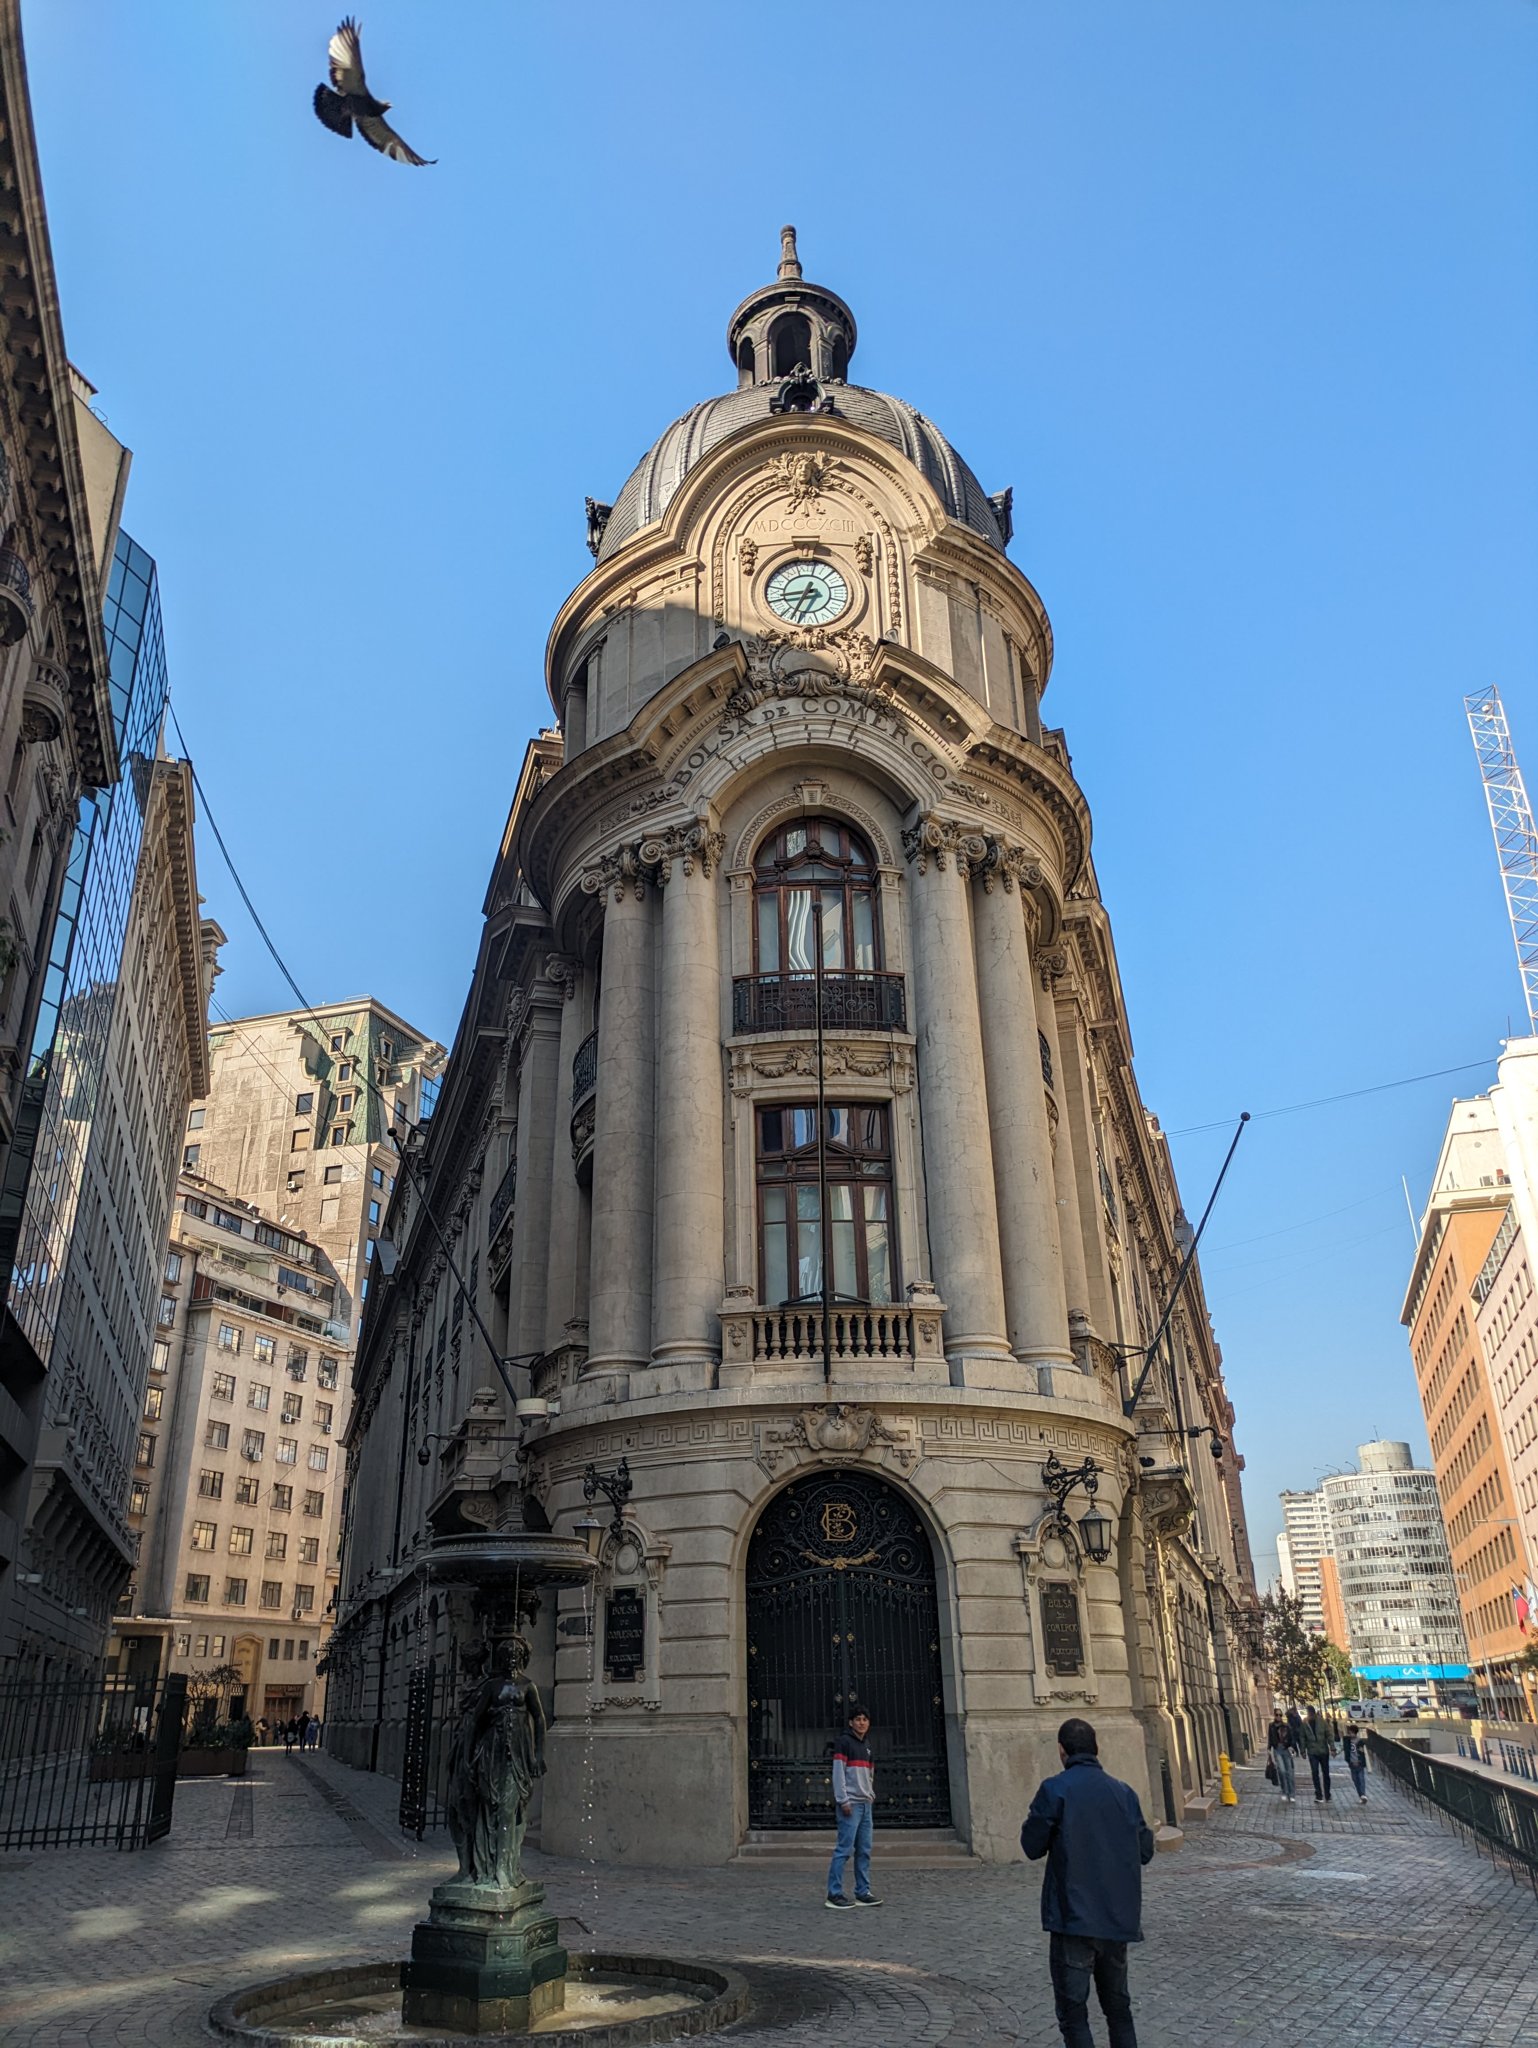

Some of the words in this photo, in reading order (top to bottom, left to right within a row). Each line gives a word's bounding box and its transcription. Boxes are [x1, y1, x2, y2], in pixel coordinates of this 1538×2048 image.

[751, 518, 856, 533] MDCCCXCIII
[671, 711, 758, 789] BOLSA
[763, 705, 791, 722] DE
[801, 698, 949, 782] COMERCIO
[1048, 1599, 1073, 1608] BOLSA
[612, 1605, 639, 1615] BOLSA
